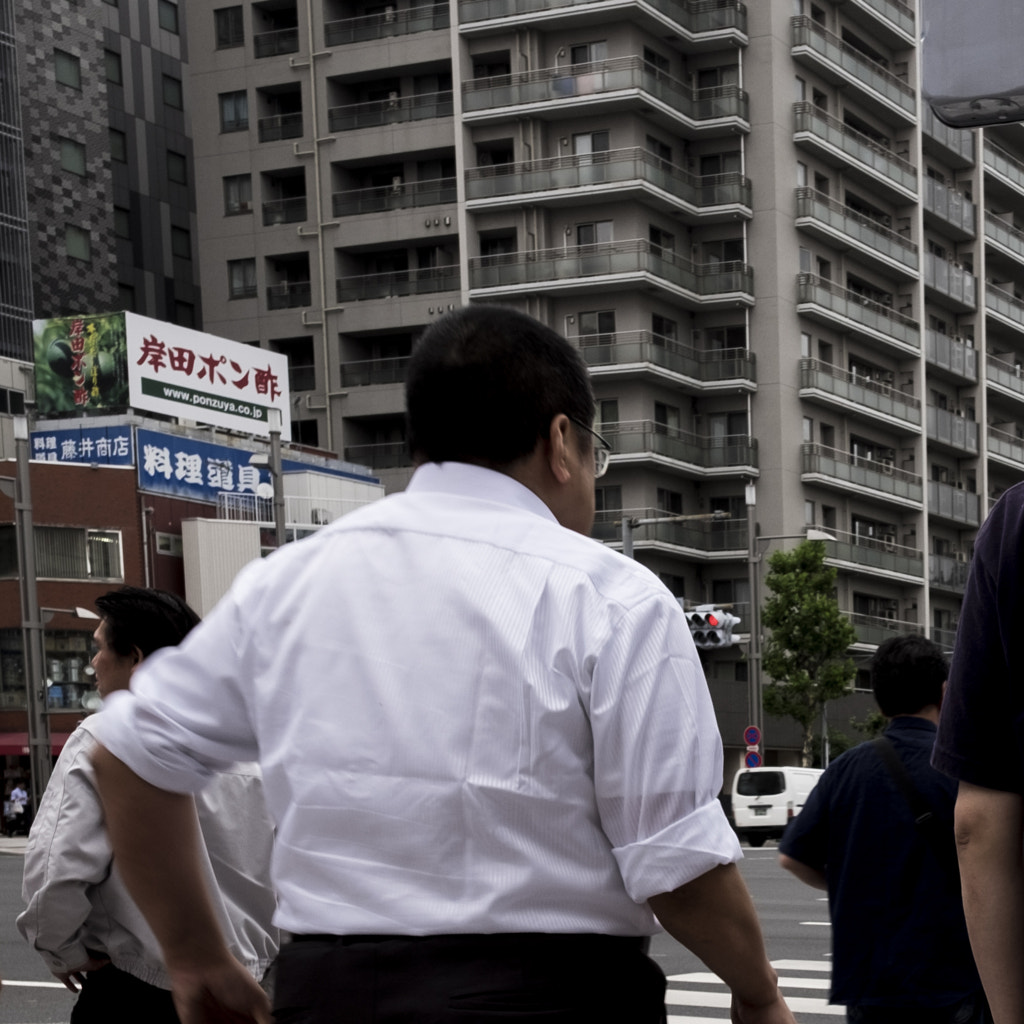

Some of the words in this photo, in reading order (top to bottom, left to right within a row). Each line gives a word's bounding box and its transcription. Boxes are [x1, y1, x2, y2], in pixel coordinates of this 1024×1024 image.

[69, 319, 91, 407] 岸田ポン酢
[136, 334, 283, 403] 岸田ポン酢
[162, 385, 264, 420] www.ponzuya.co.jp
[61, 435, 129, 461] 藤井商店
